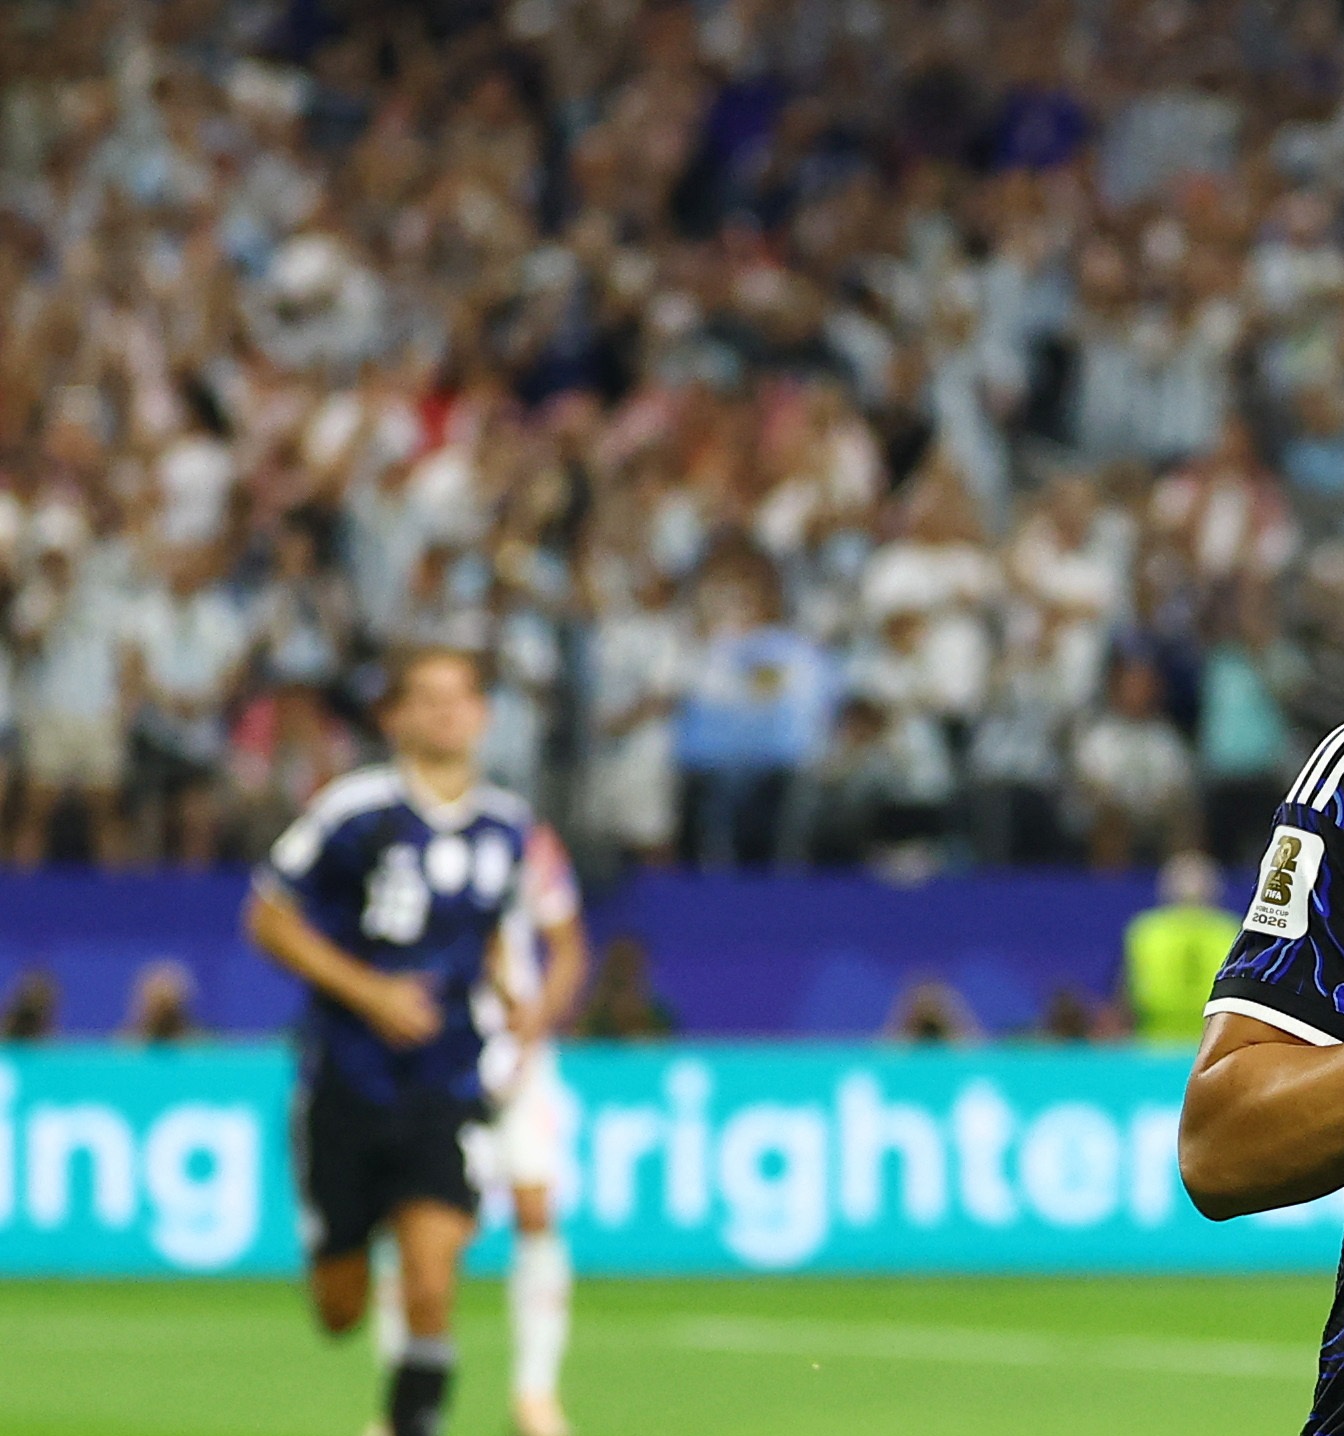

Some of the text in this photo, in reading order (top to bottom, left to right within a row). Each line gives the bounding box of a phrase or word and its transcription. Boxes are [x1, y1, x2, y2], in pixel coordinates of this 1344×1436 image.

[1264, 888, 1282, 900] FIFA
[1275, 909, 1289, 917] CUP
[1252, 912, 1288, 929] 2026
[555, 1057, 1180, 1268] righter
